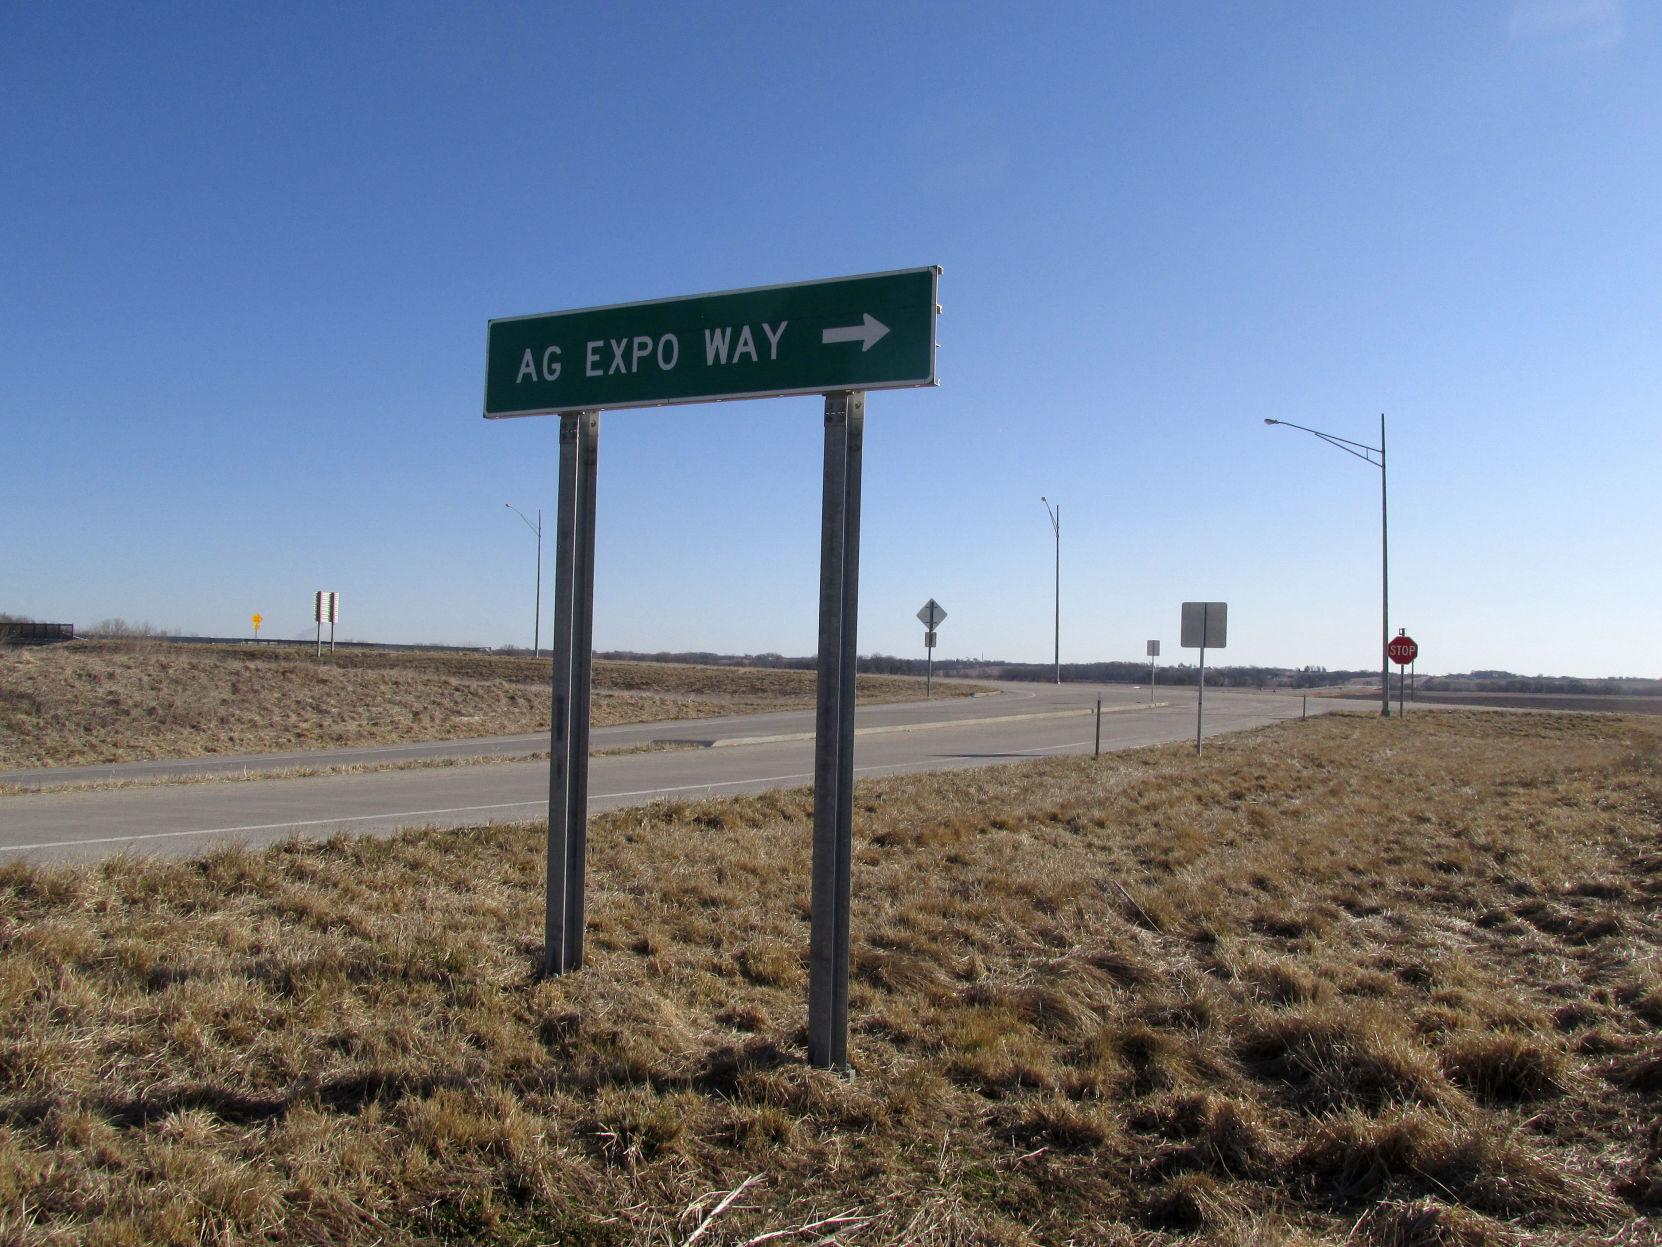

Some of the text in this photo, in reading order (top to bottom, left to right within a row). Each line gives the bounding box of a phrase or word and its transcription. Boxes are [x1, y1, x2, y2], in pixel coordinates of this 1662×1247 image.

[516, 320, 788, 384] AG EXPO WAY
[1390, 645, 1416, 656] STOP
